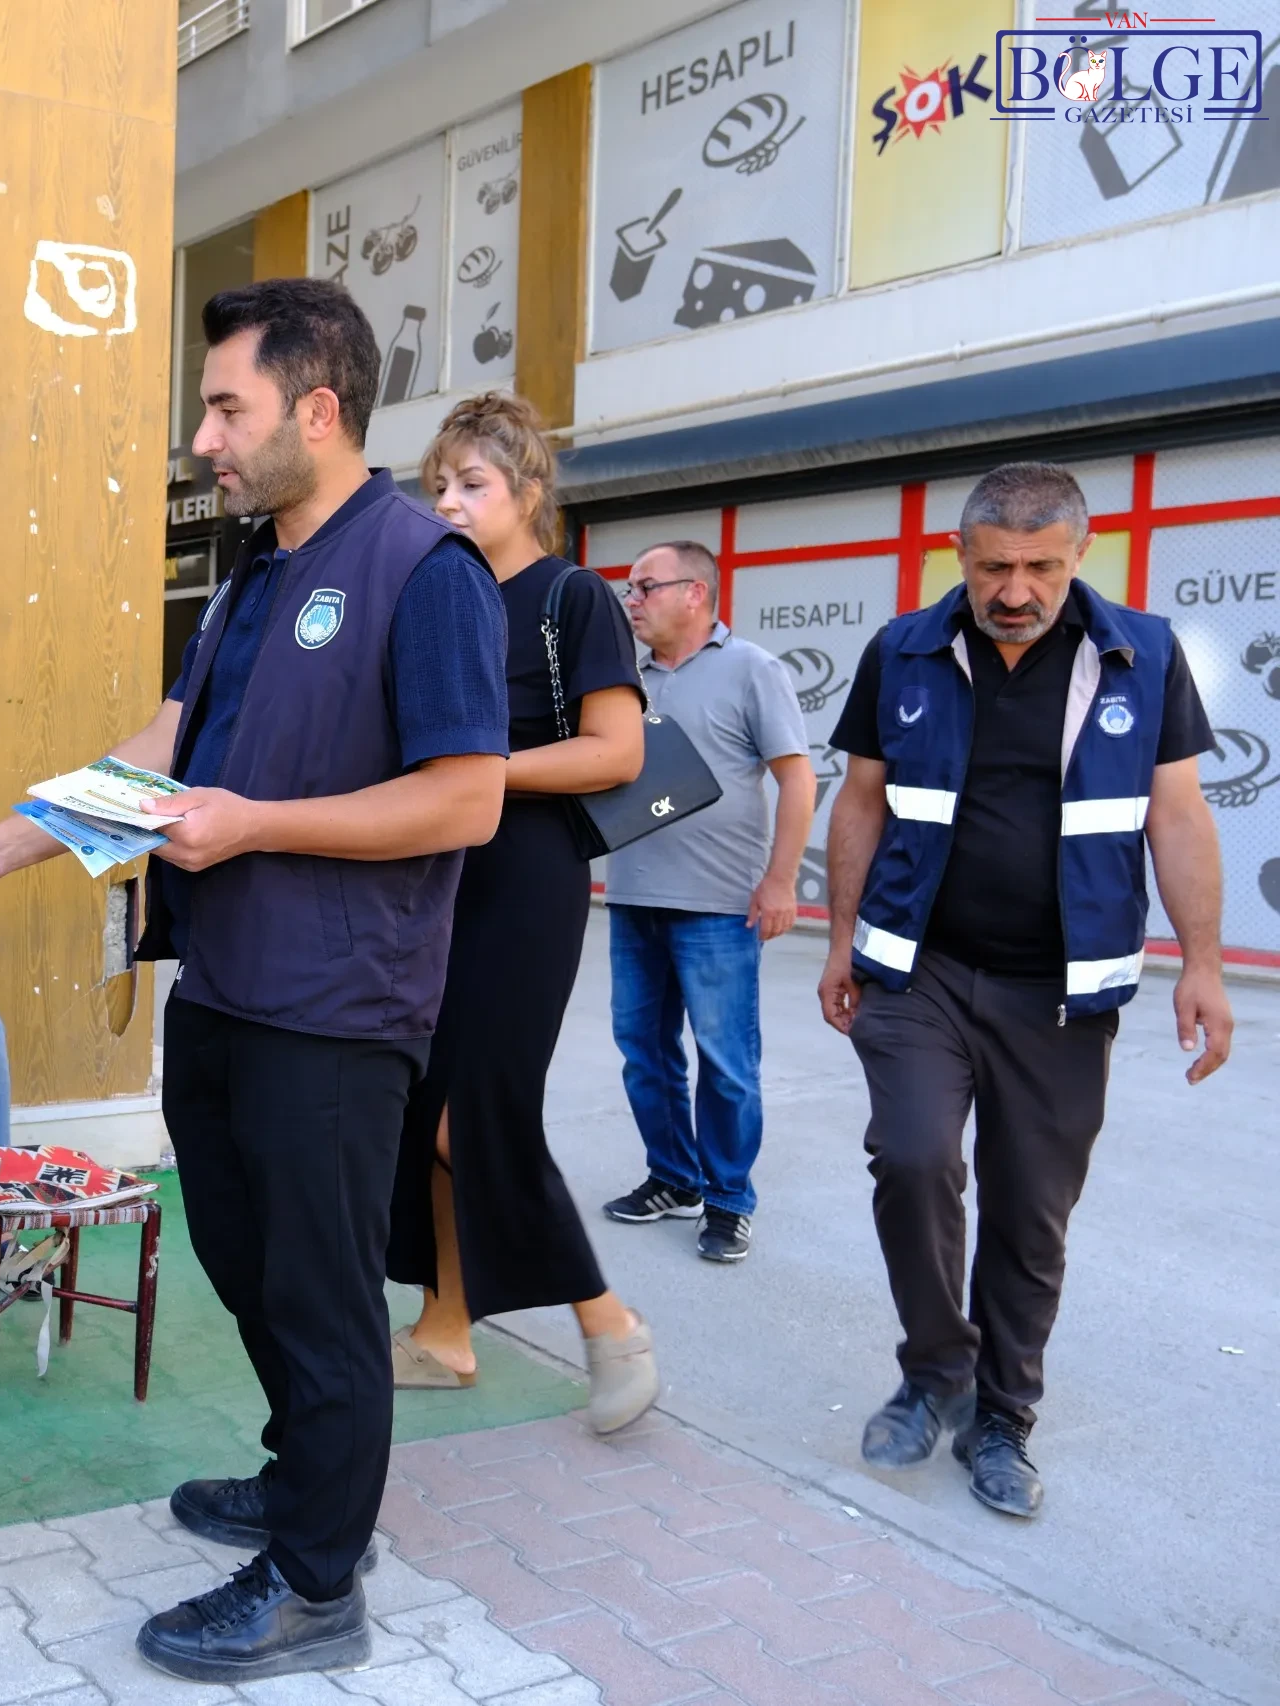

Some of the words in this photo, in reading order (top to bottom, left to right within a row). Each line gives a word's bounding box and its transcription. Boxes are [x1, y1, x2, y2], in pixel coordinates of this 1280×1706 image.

[641, 20, 795, 115] HESAPLI
[872, 54, 993, 157] ŞOK
[314, 594, 340, 604] ZABITA
[1175, 569, 1276, 606] GÜVE
[759, 601, 863, 630] HESAPLI
[1100, 695, 1127, 704] ZABITA
